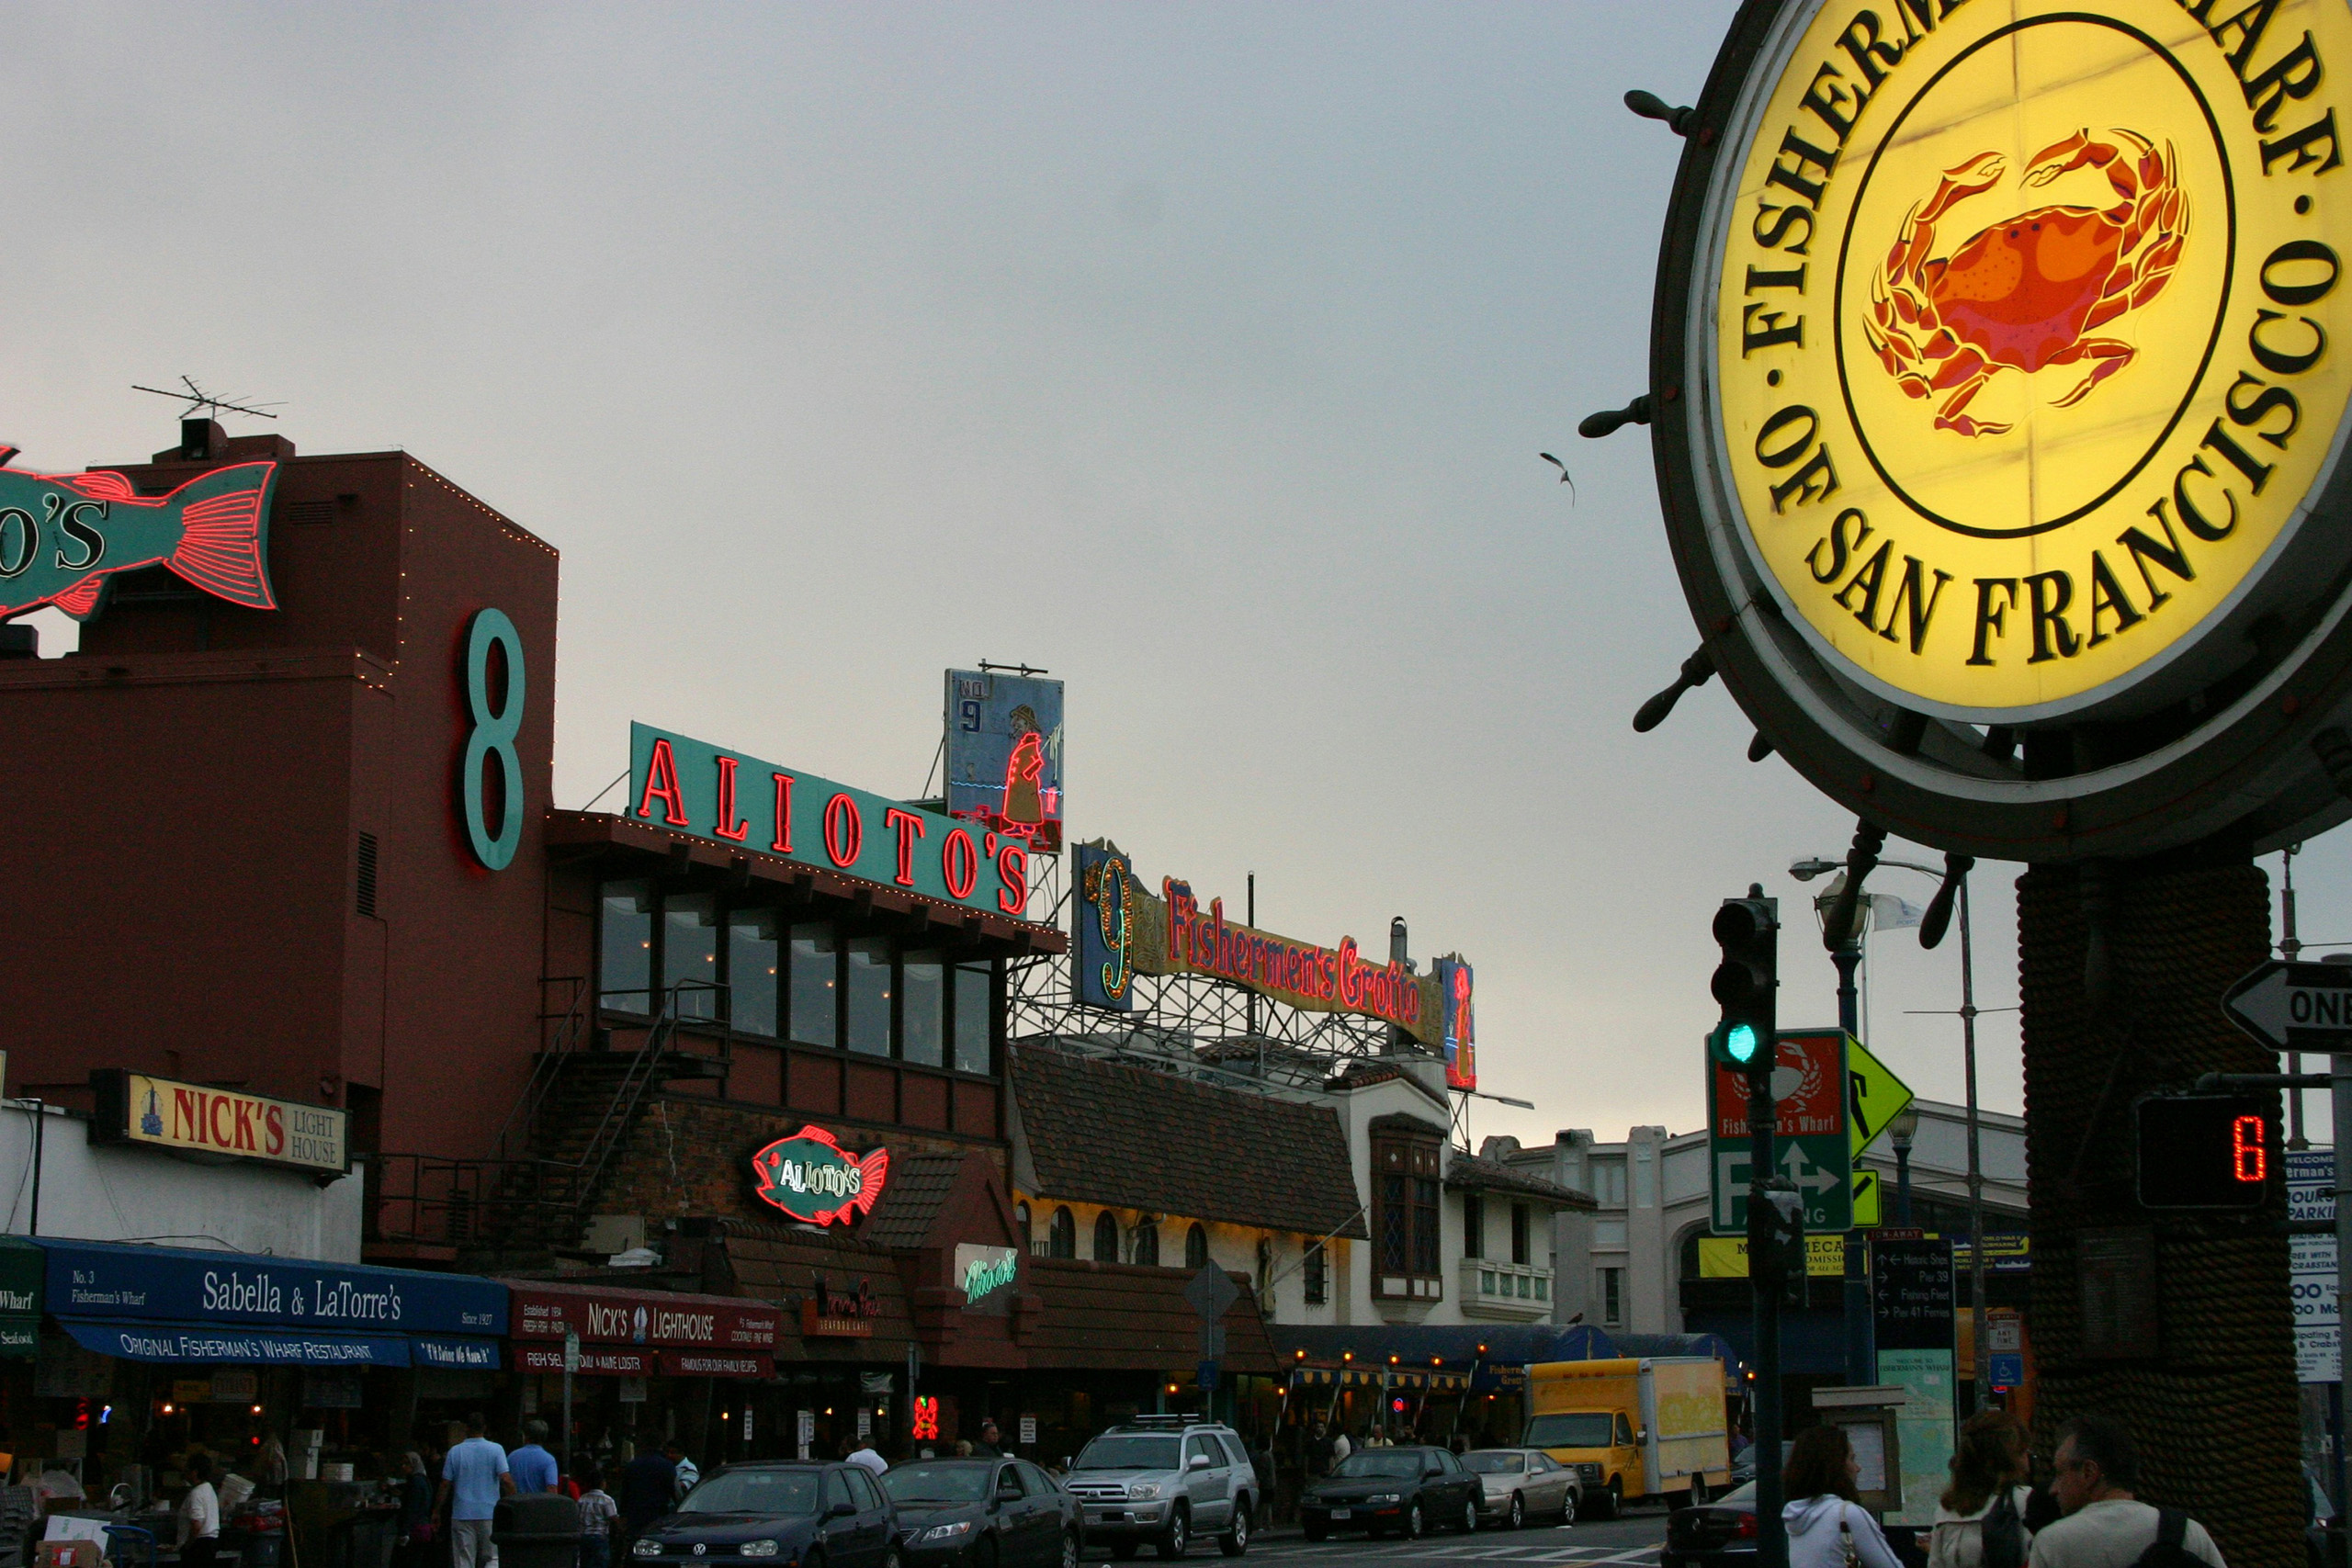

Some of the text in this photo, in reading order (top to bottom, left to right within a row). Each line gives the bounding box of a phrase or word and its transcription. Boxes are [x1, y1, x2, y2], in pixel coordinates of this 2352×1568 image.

[2175, 0, 2344, 177] ARF
[1755, 239, 2342, 667] OF SAN FRANCISCO
[960, 699, 982, 733] 9
[465, 607, 525, 871] 8
[638, 739, 1028, 915] ALIOTO'S
[1162, 874, 1420, 1024] Fishermen's Grotto
[173, 1088, 284, 1156] NICK'S
[293, 1110, 334, 1138] LIGHT
[1723, 1114, 1835, 1134] Fishn's Wharf
[291, 1135, 336, 1164] HOUSE
[2233, 1115, 2266, 1182] 6
[780, 1159, 861, 1198] ALIOTO'S
[2286, 1166, 2335, 1178] erman's
[73, 1269, 95, 1284] No. 3
[1937, 1270, 1949, 1282] 39
[0, 1290, 34, 1311] Wharf
[72, 1289, 146, 1306] Fisherman's Wharf
[203, 1270, 401, 1321] Sabella & LaTorre's
[588, 1303, 714, 1341] NICK'S LIGHTHOUSE
[119, 1334, 374, 1360] ORIGINAL FISHERMAN'S WHARF RESTAURANT
